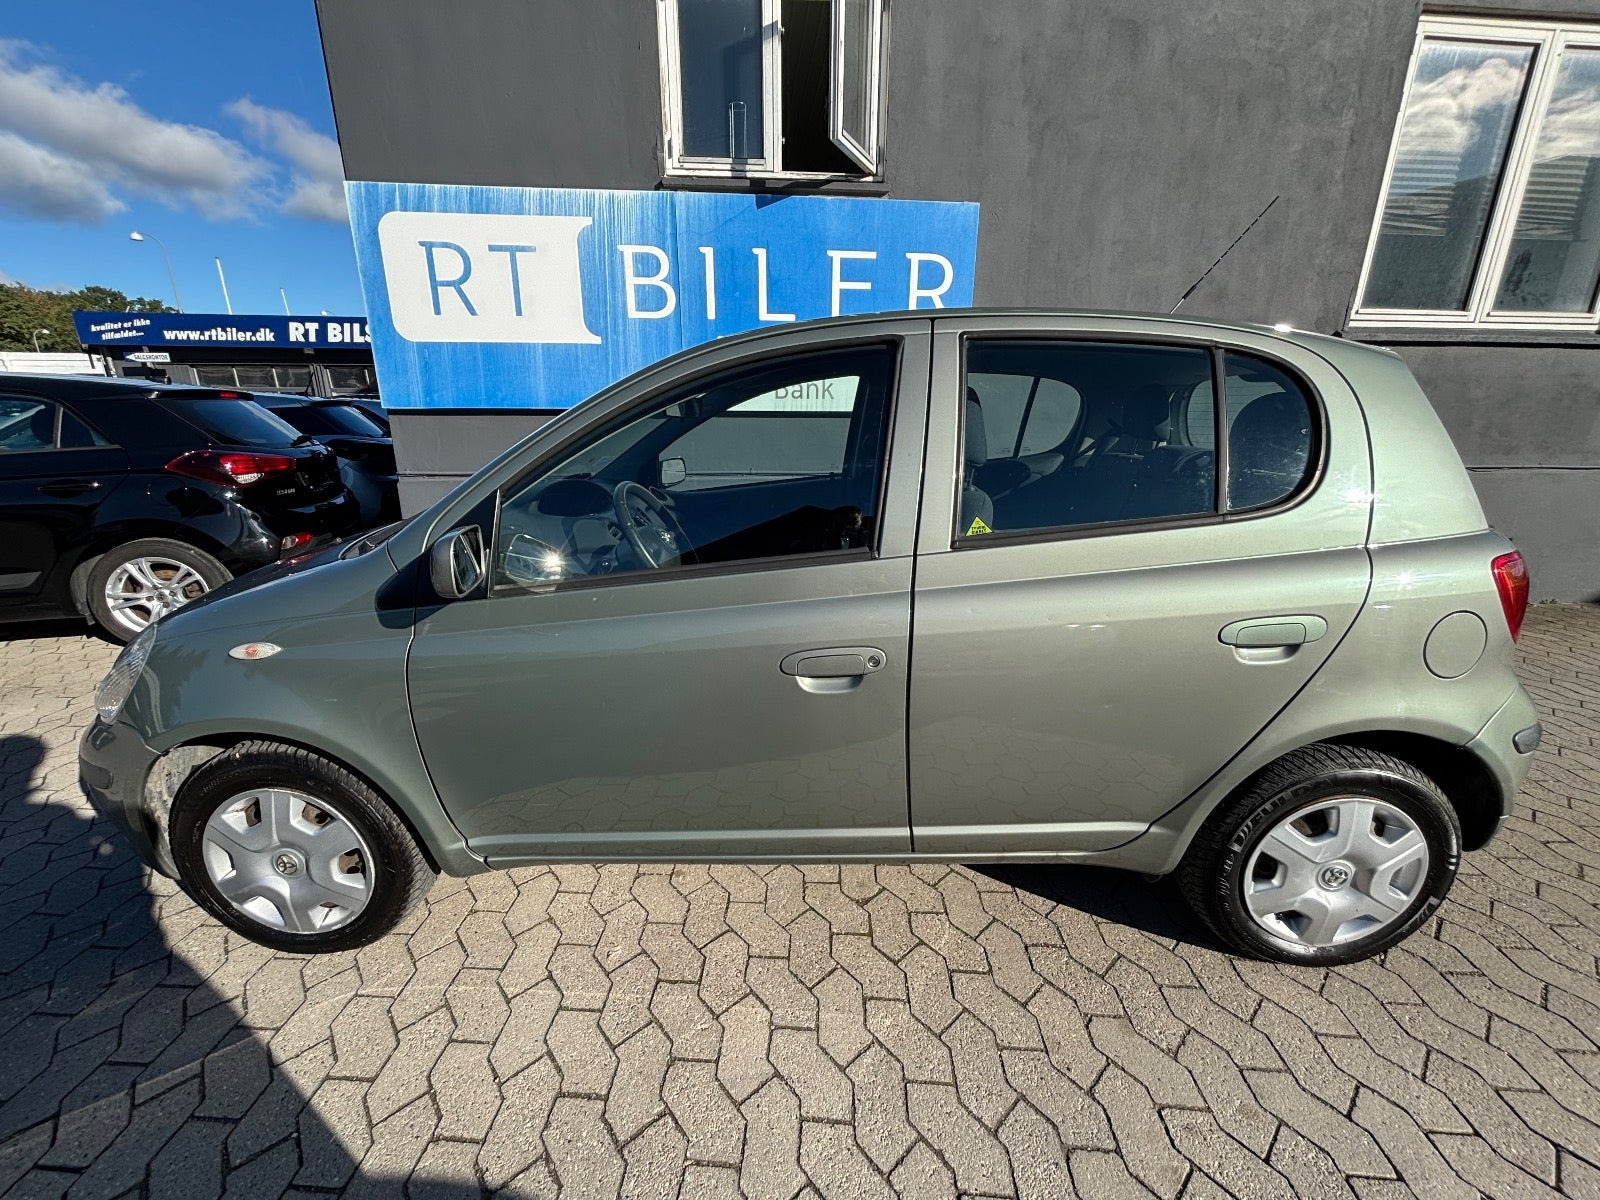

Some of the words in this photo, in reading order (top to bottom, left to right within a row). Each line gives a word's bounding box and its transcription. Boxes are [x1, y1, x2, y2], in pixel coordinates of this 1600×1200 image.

[417, 240, 537, 317] RT
[617, 244, 954, 321] BILER
[91, 322, 121, 332] kvalitet
[133, 318, 151, 327] ikke
[289, 322, 319, 342] RT
[163, 327, 276, 342] www.rtbiler.dk
